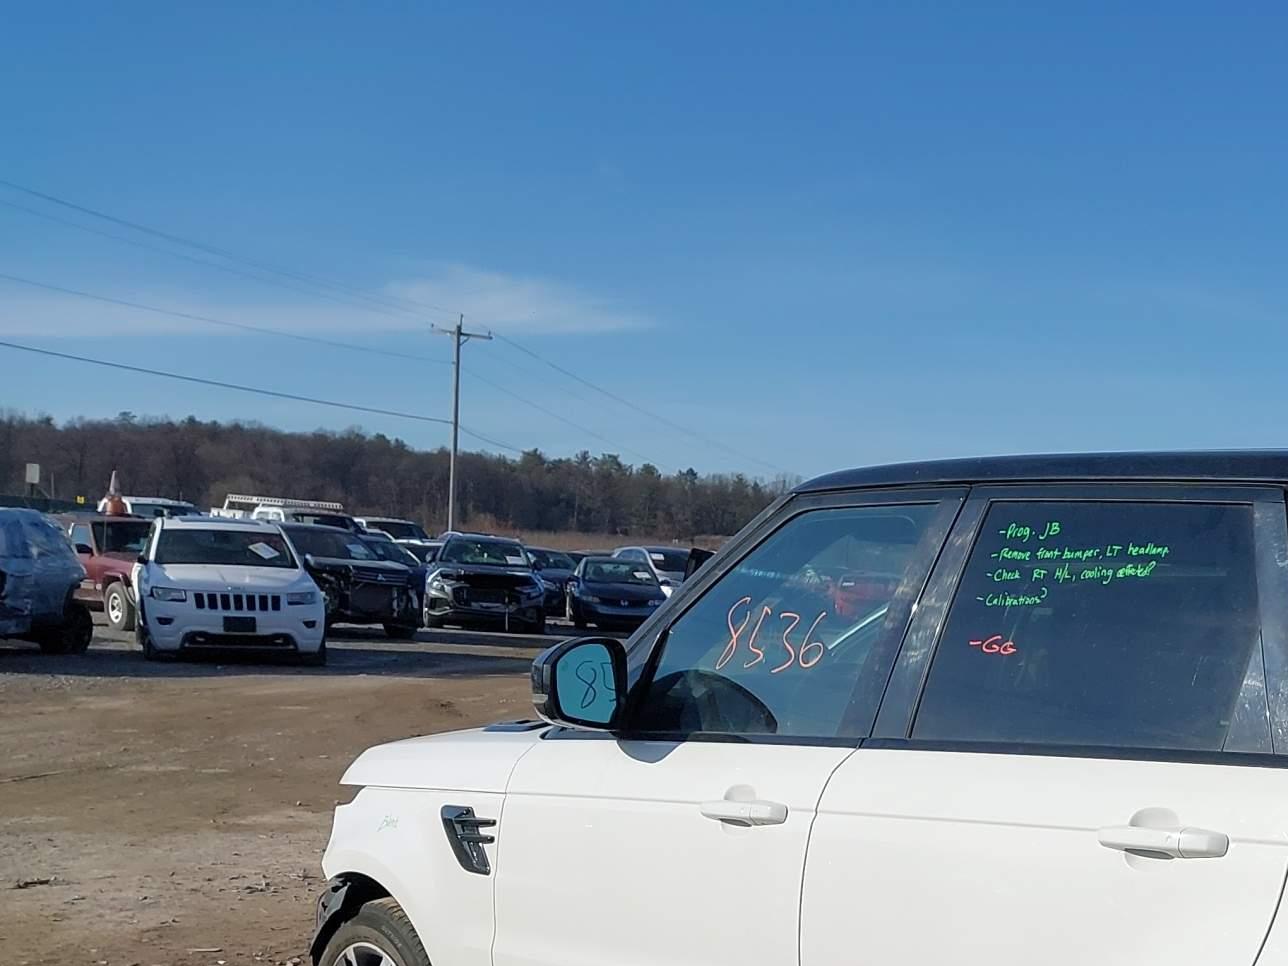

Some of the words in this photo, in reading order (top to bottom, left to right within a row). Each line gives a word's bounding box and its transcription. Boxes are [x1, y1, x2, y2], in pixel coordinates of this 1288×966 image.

[1038, 522, 1061, 540] JB
[1106, 545, 1123, 557] LT
[1031, 568, 1048, 582] RT
[1080, 565, 1114, 585] cooling
[716, 596, 828, 674] 8536
